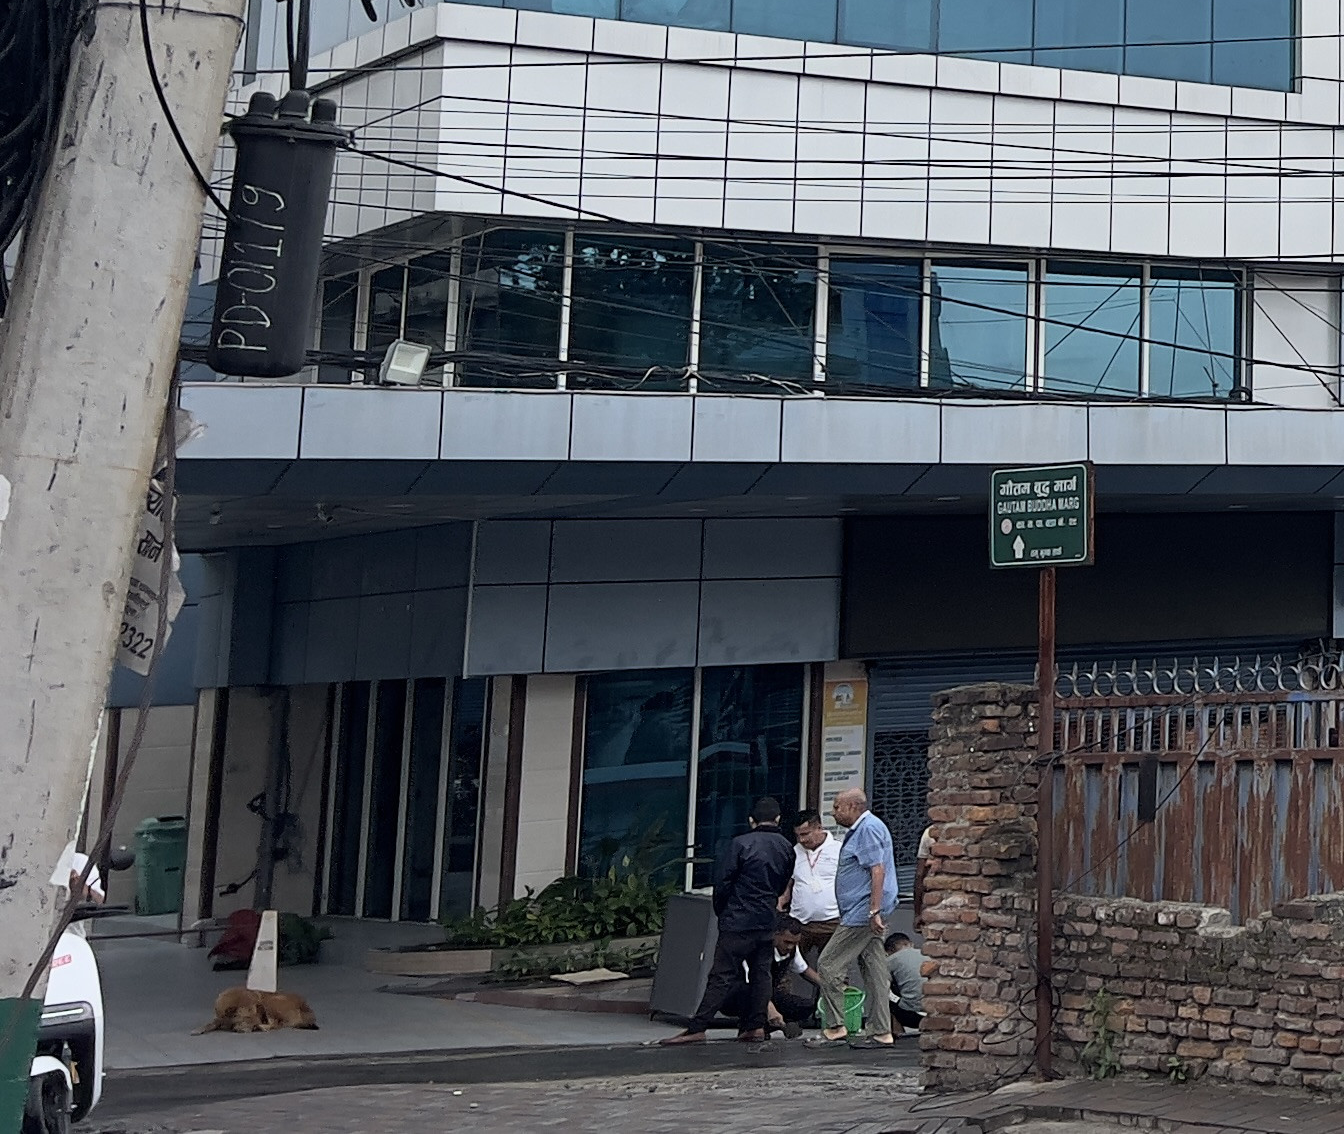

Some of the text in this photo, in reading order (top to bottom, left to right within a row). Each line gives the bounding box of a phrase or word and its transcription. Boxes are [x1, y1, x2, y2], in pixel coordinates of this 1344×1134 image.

[999, 475, 1077, 497] गौतम बुद्ध मार्ग
[997, 496, 1080, 514] GAUTAM BUDDHA MARG
